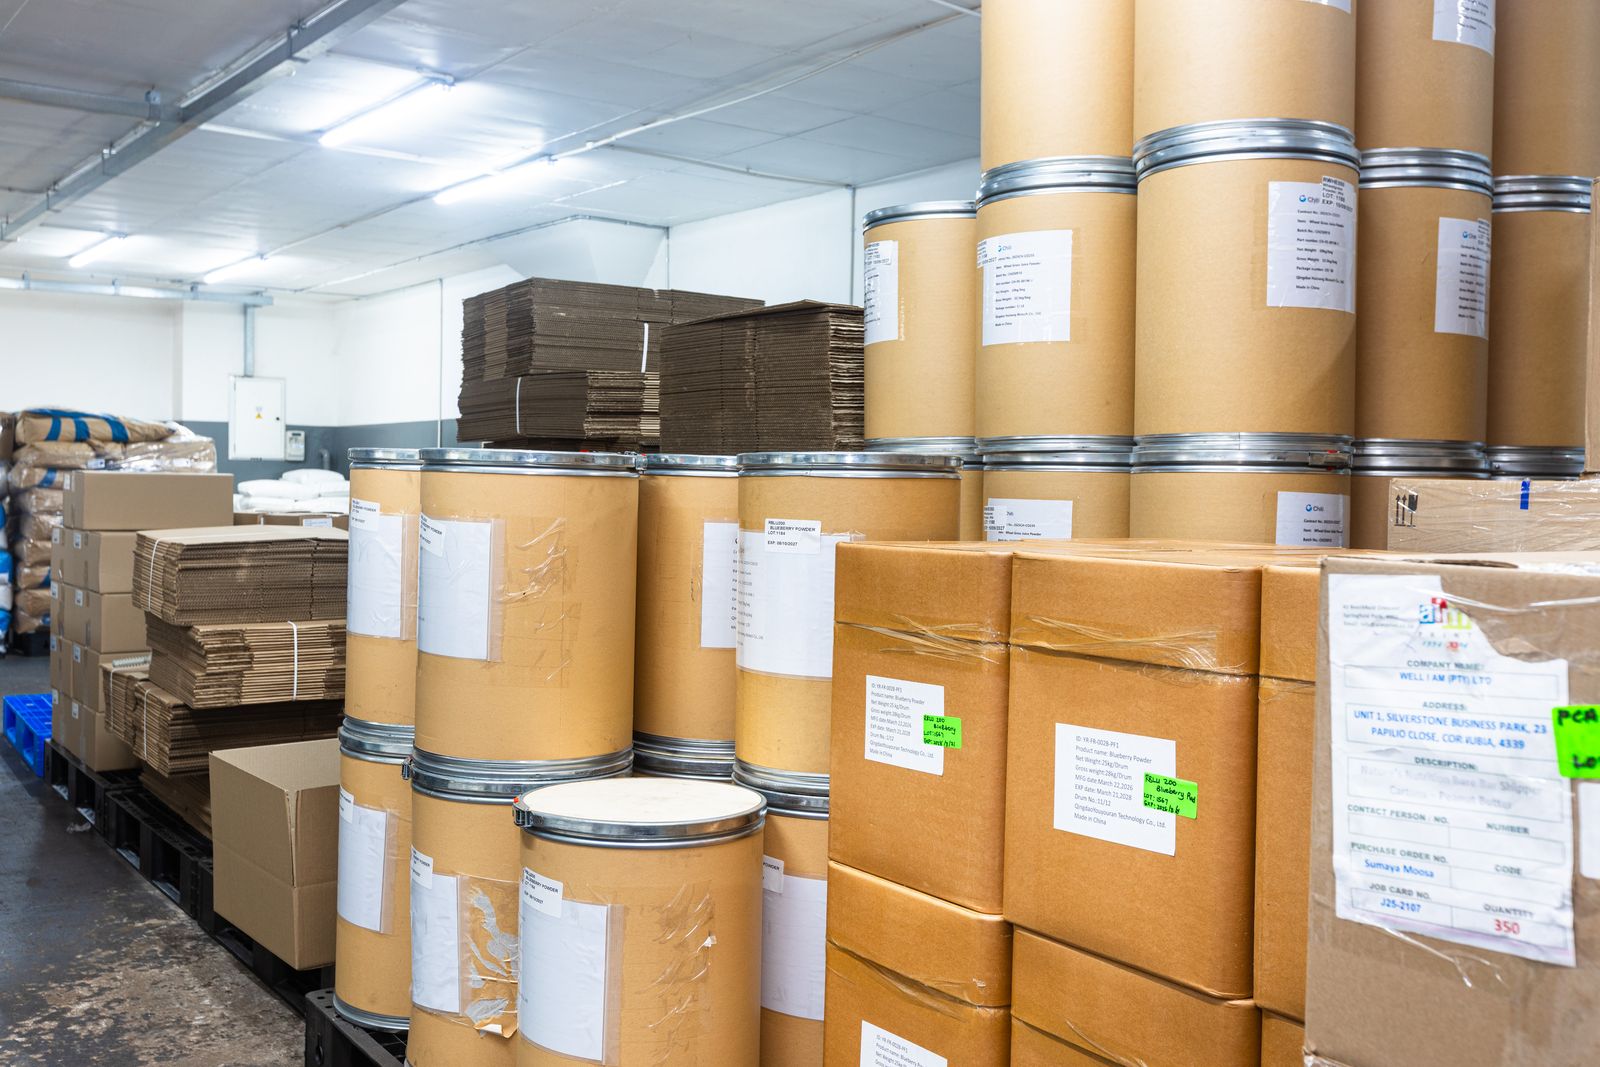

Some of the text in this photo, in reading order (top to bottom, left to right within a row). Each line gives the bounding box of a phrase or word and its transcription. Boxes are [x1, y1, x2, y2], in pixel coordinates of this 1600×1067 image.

[1407, 660, 1451, 669] COMPANY
[1400, 672, 1424, 681] WELL
[1432, 674, 1445, 682] AM
[1448, 674, 1470, 685] (PTY)
[1472, 676, 1492, 685] LTD
[1423, 701, 1467, 711] ADDRESS:
[1354, 711, 1374, 719] UNIT
[1387, 713, 1450, 726] SILVERSTONE
[1451, 718, 1496, 730] BUSINESS
[1499, 721, 1530, 734] PARK,
[1534, 724, 1546, 733] 23
[1557, 708, 1598, 726] PCA
[1371, 727, 1406, 738] PAPILIO
[1500, 739, 1525, 749] 4339
[1075, 745, 1093, 754] Product
[1109, 750, 1132, 761] Blueberry
[1133, 755, 1152, 764] Powder
[1075, 764, 1088, 772] Gross
[1415, 757, 1477, 770] DESCRIPTION:
[1163, 778, 1177, 787] 200
[1074, 793, 1087, 801] Drum
[1097, 788, 1112, 796] March
[1074, 813, 1087, 821] Made
[1093, 817, 1107, 825] China
[1118, 812, 1145, 824] Technology
[1347, 804, 1449, 824] CONTACT PERSON NO.
[1486, 822, 1530, 835] NUMBER
[1351, 842, 1448, 863] PURCHASE ORDER NO.
[1364, 859, 1434, 878] Sumaya Moosa
[1495, 864, 1522, 875] CODE
[1369, 883, 1386, 891] JOB
[1389, 886, 1414, 896] CARD
[1380, 898, 1421, 912] J25-2107
[1483, 904, 1534, 918] QUANTITY
[1494, 919, 1520, 935] 350
